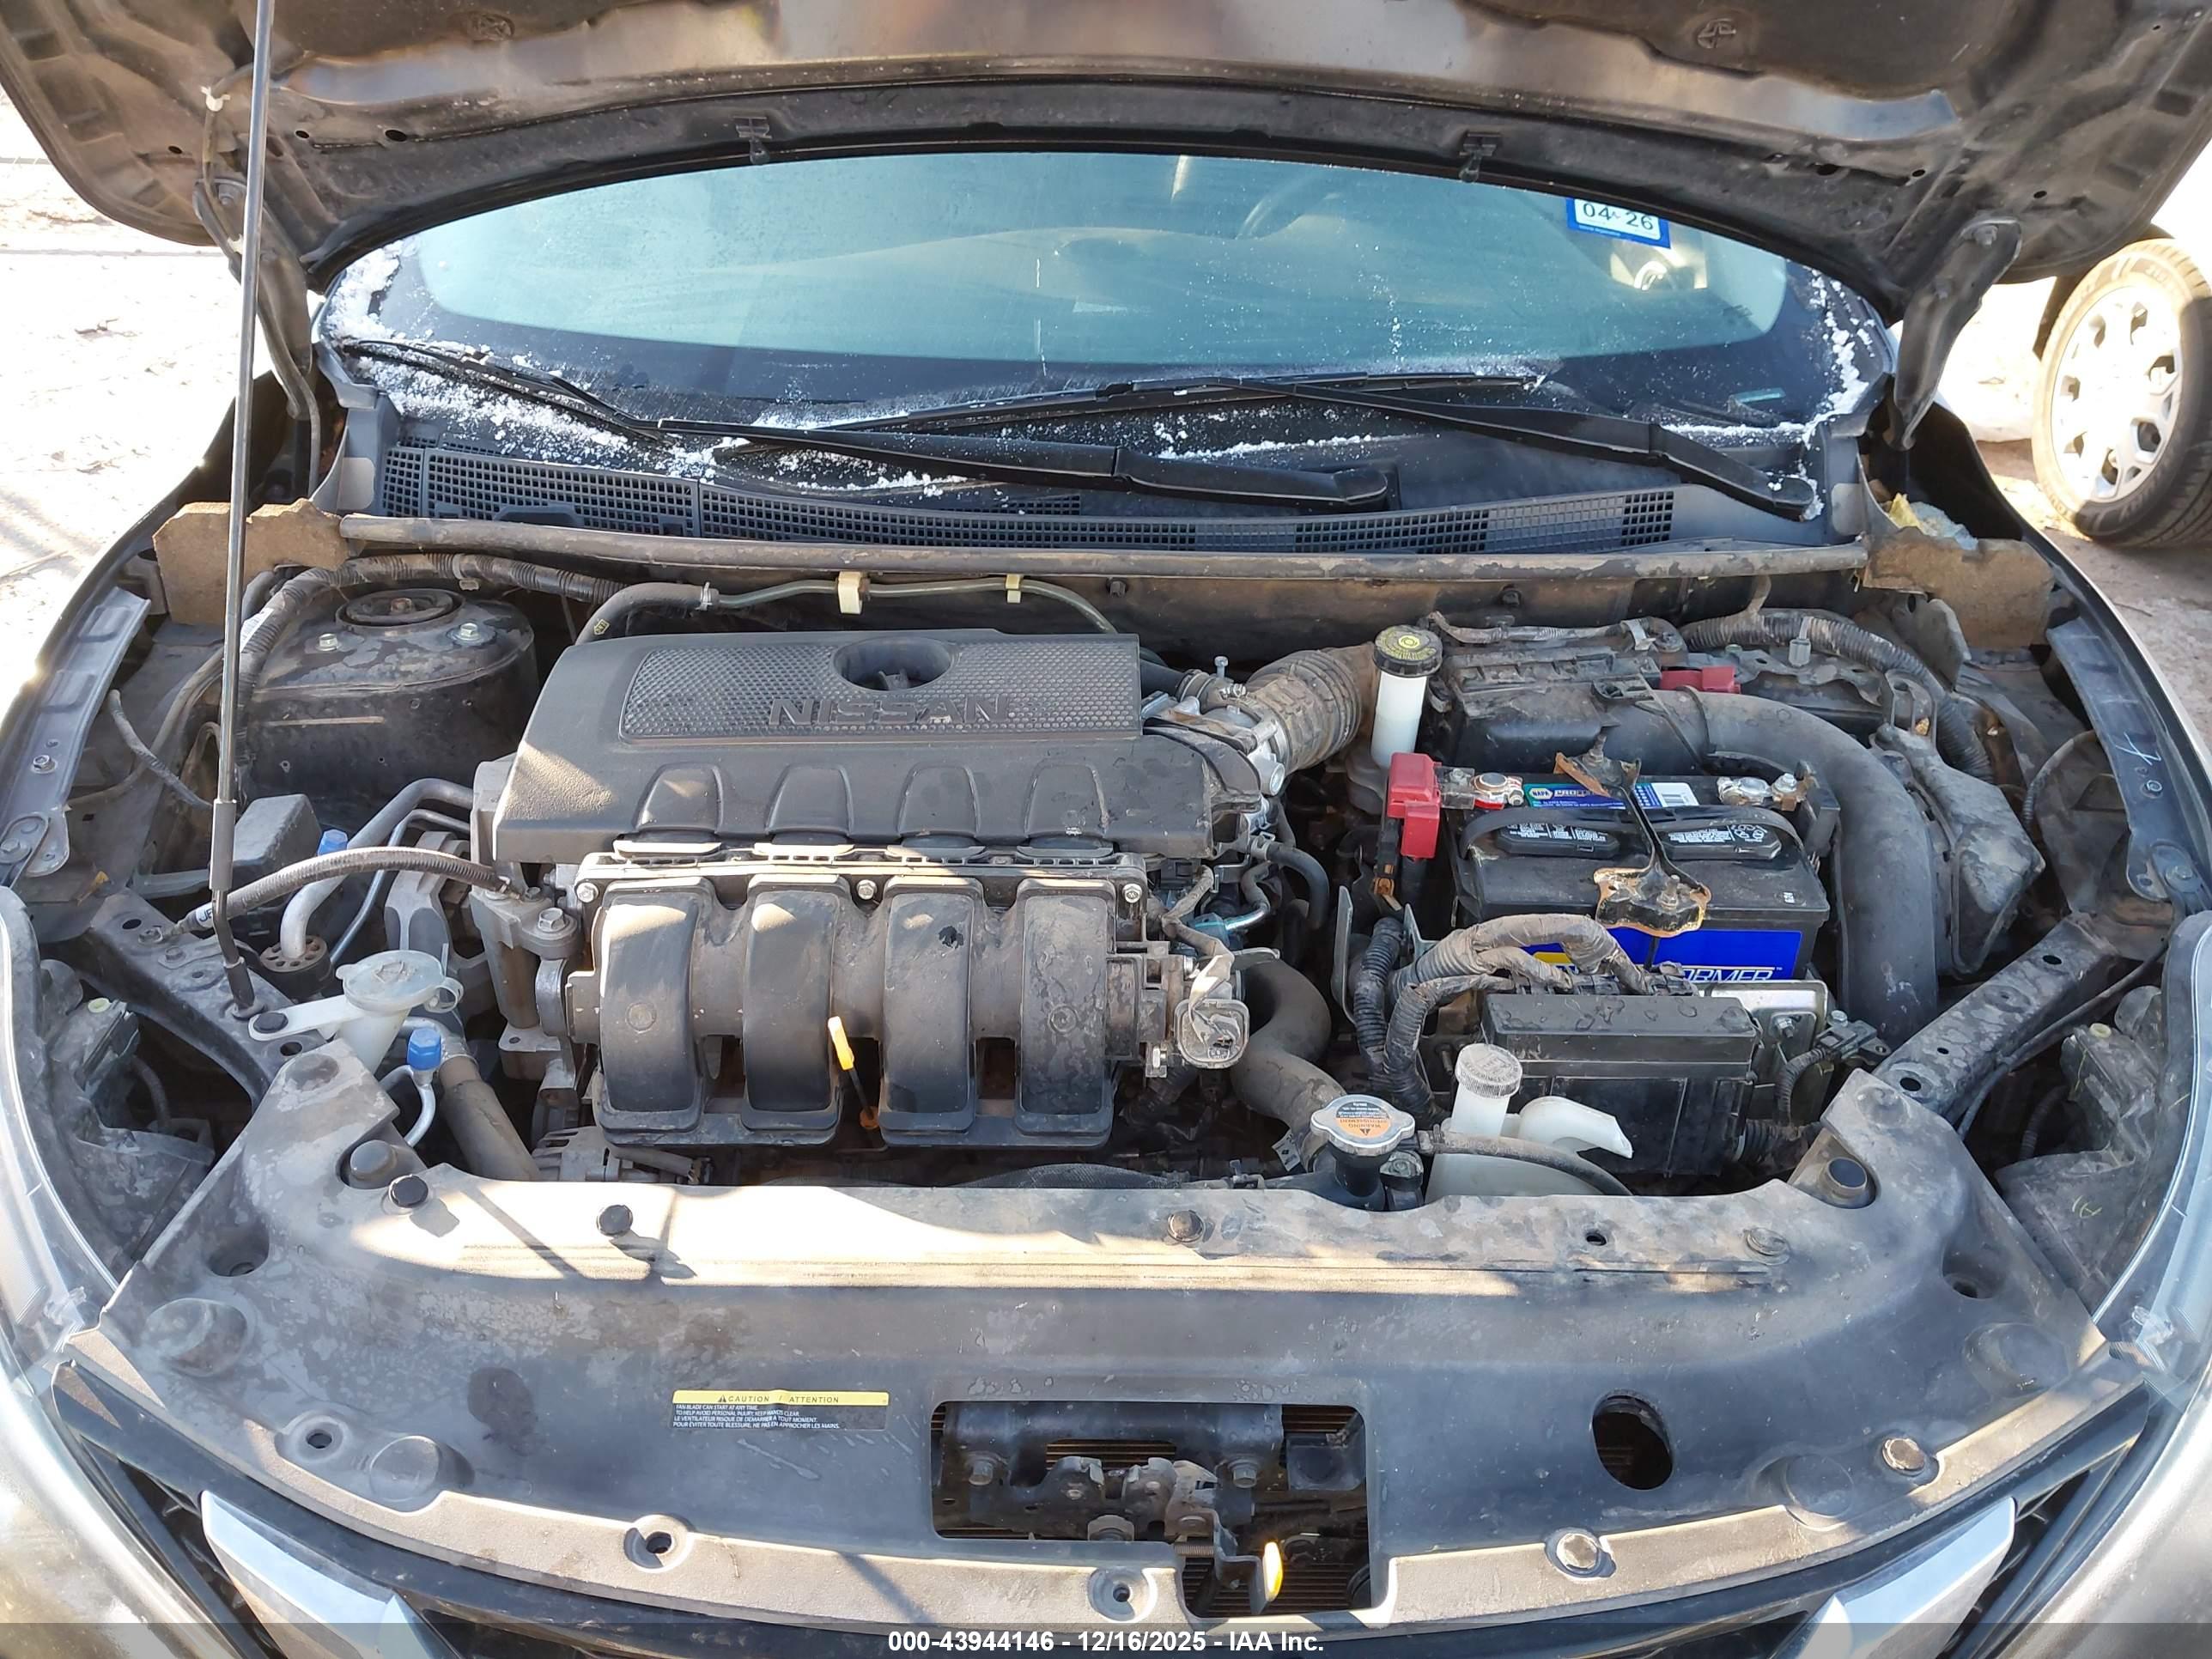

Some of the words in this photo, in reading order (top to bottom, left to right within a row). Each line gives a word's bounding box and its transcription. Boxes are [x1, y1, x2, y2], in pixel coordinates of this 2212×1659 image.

[1583, 203, 1612, 221] 04
[1626, 211, 1654, 231] 26
[769, 694, 1010, 725] NISSAN
